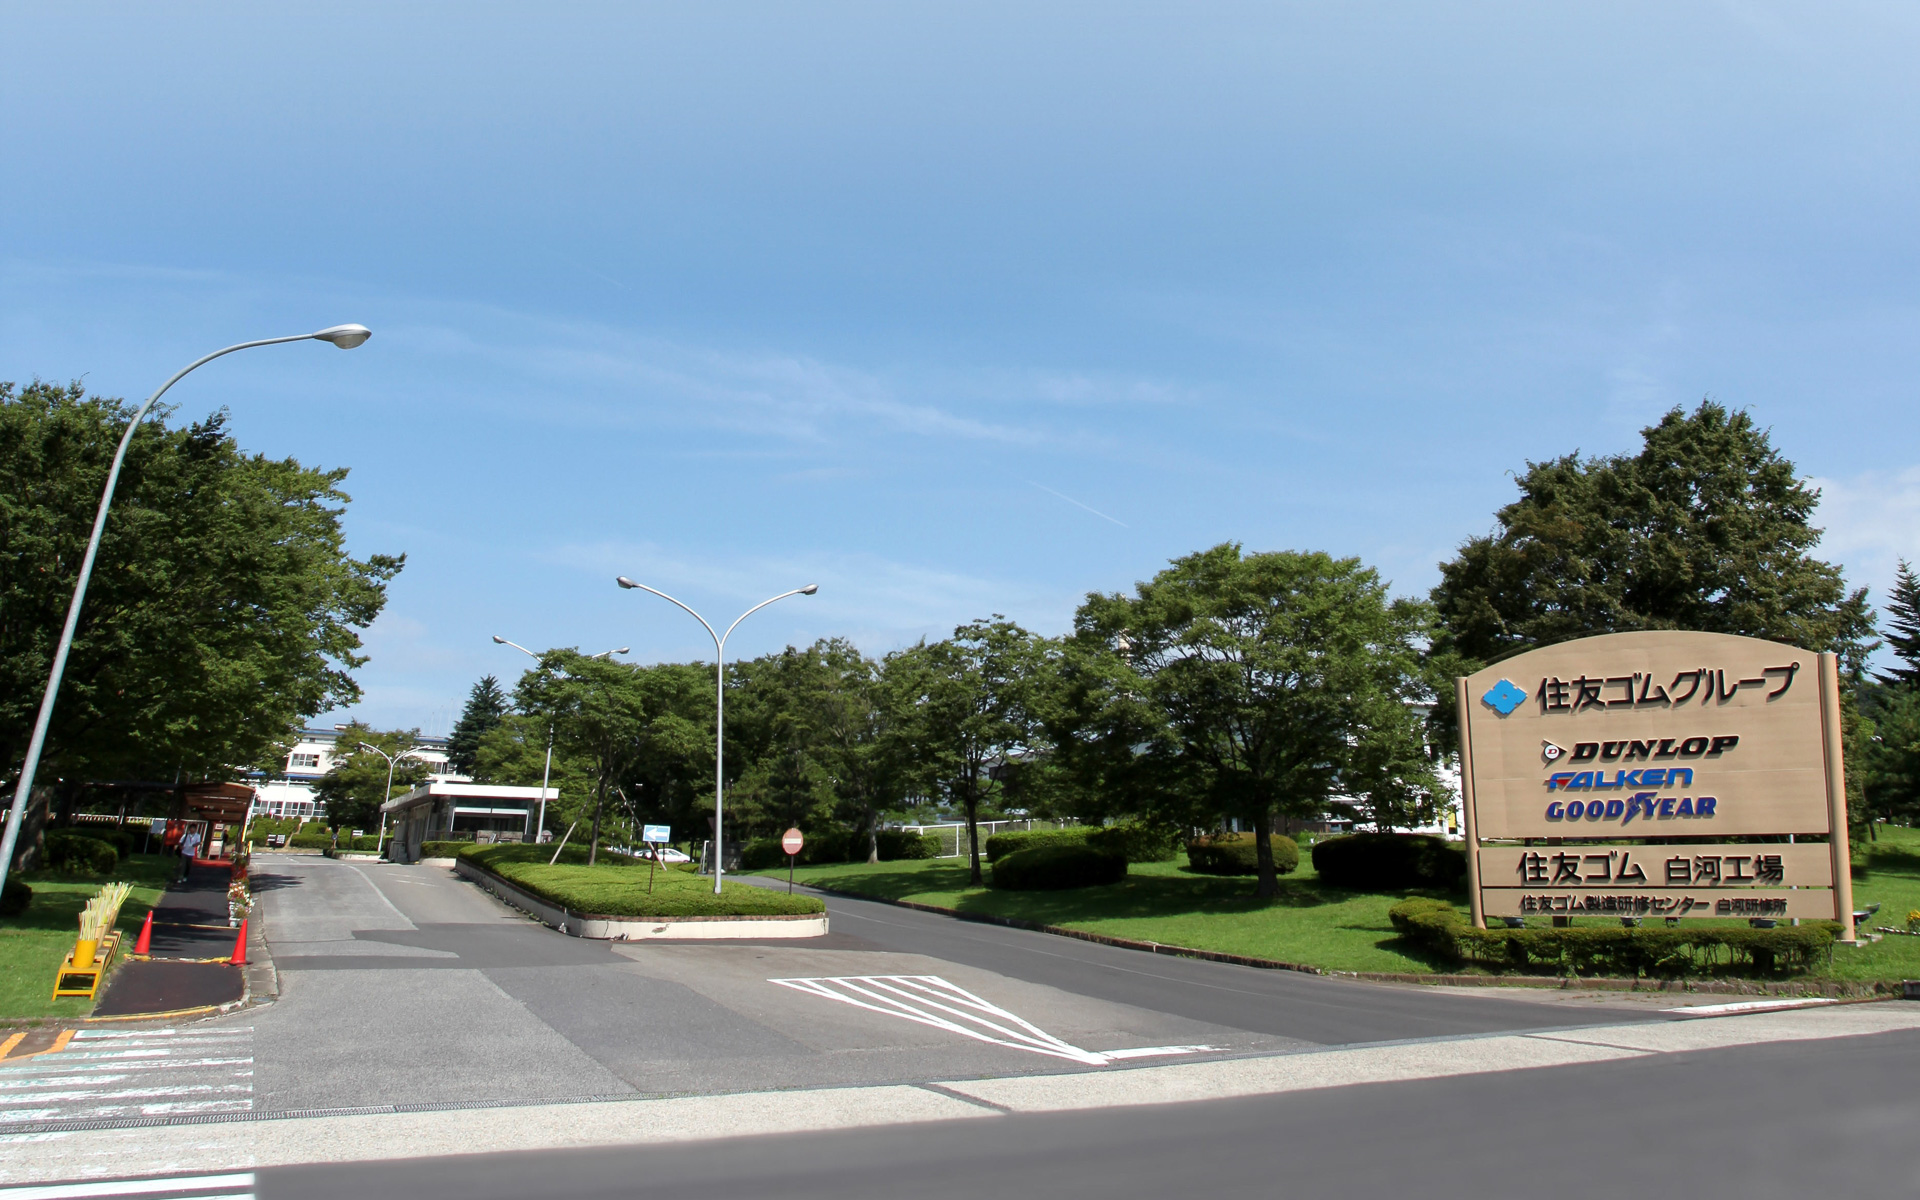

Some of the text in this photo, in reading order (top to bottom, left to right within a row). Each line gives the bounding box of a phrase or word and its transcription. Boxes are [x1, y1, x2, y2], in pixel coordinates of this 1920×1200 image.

[1538, 661, 1800, 711] 住友ゴムグループ
[1570, 735, 1739, 761] DUNLOP
[1547, 767, 1694, 789] FALKEN
[1547, 792, 1717, 822] GOODYEAR
[1518, 850, 1784, 882] 住友ゴム 白河工場
[1520, 894, 1788, 912] 住友ゴム製造研修センター 白河研修所
